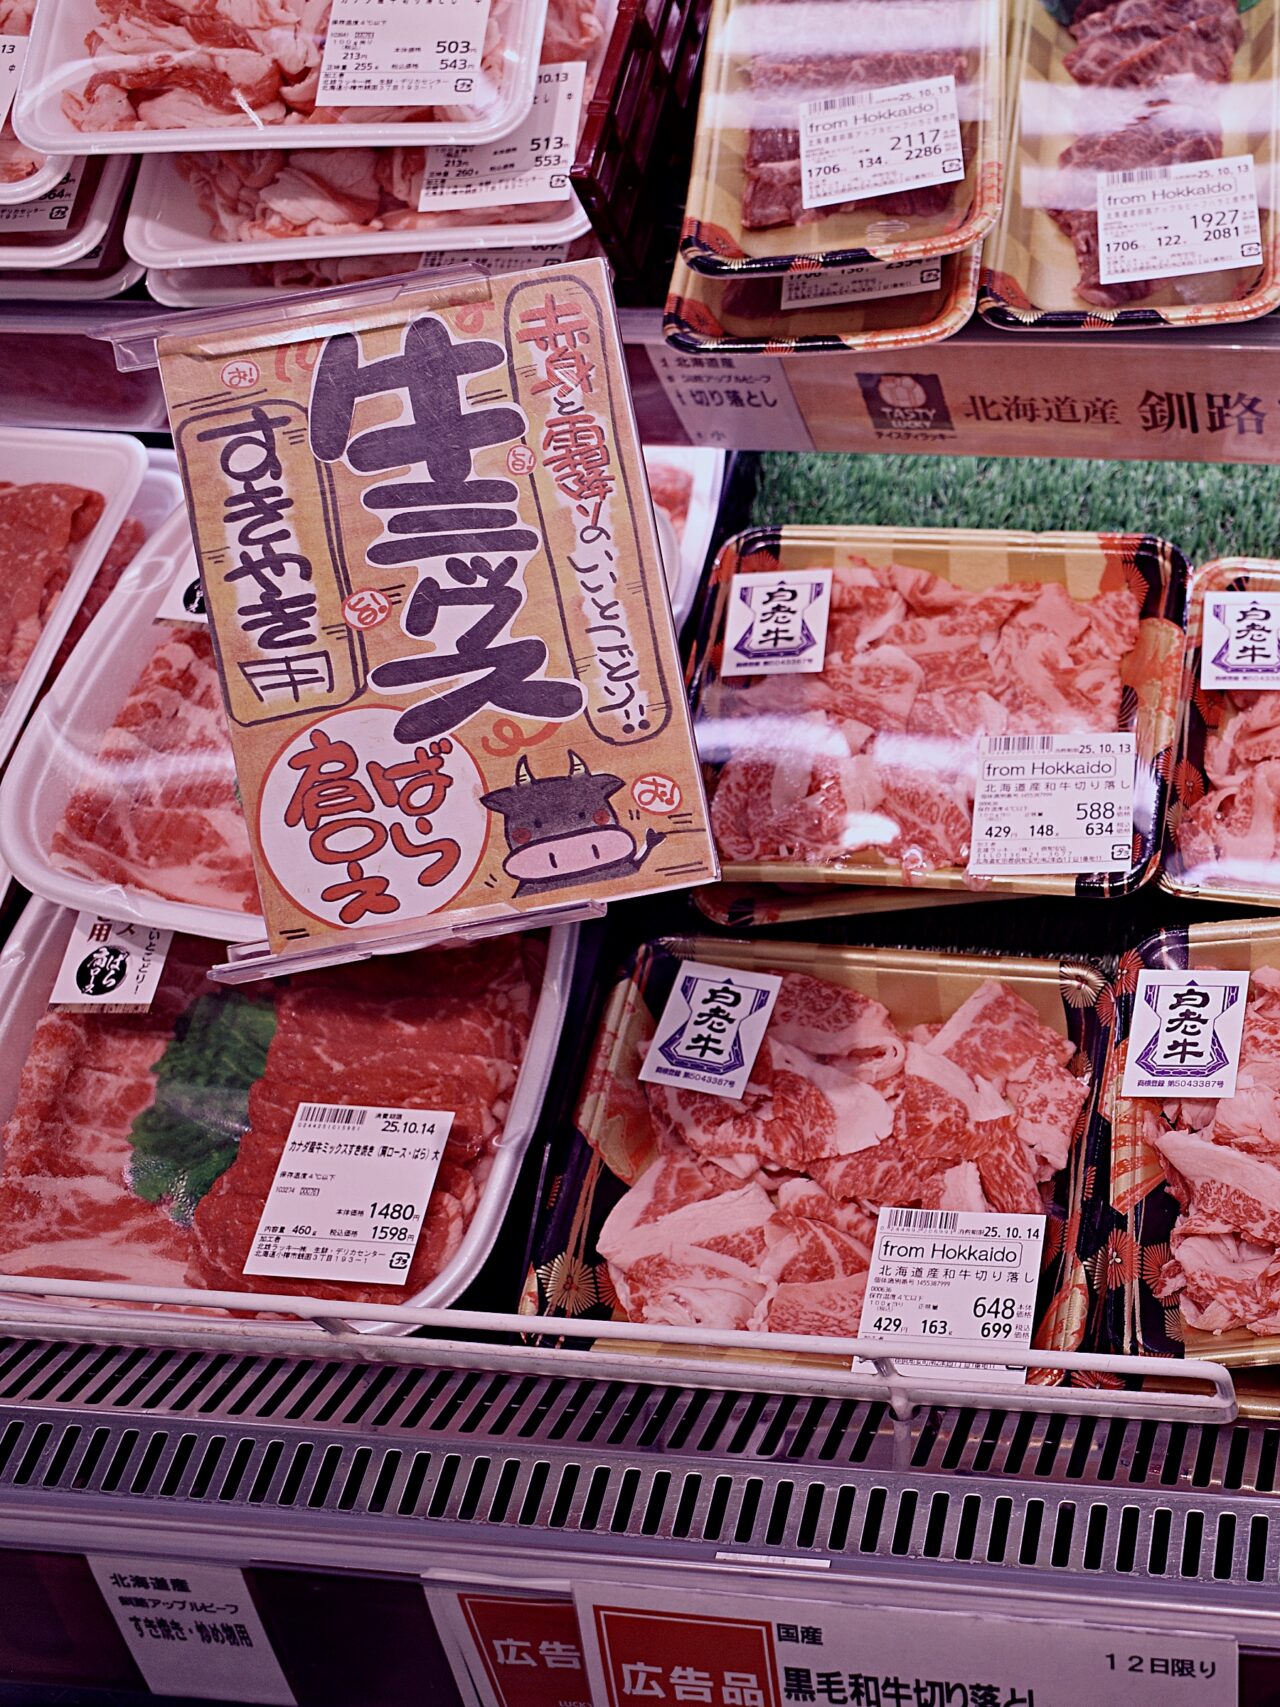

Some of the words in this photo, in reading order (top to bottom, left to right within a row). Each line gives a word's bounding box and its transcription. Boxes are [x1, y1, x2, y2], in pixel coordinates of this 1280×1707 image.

[808, 119, 848, 133] from
[854, 102, 934, 125] Hokkaido
[890, 129, 940, 150] 2117
[905, 145, 942, 161] 2286
[1107, 195, 1146, 206] from
[1152, 182, 1232, 200] Hokkaido
[1191, 210, 1239, 229] 1927
[1203, 227, 1240, 242] 2081
[676, 358, 736, 368] 北海道産
[691, 390, 778, 408] 切り落とし
[880, 407, 937, 420] TASTY
[963, 395, 1121, 426] 北海道産
[310, 316, 584, 744] 牛ミックス
[197, 406, 334, 702] すきやき用
[758, 587, 798, 648] 白老牛
[1235, 607, 1272, 664] 白老牛
[986, 763, 1025, 776] from
[1032, 760, 1112, 775] Hokkaido
[985, 780, 1130, 792] 北海道産和牛切り落し
[367, 738, 461, 887] ばら
[1076, 802, 1115, 820] 588
[284, 729, 400, 924] 肩ロース
[1085, 822, 1113, 836] 634
[685, 986, 742, 1058] 白老牛
[1163, 988, 1210, 1064] 白老牛
[381, 1121, 435, 1135] 25.10.14
[883, 1241, 924, 1258] from
[931, 1243, 1017, 1262] Hokkaido
[879, 1264, 1035, 1284] 北海道産和牛切り落し
[973, 1296, 1015, 1320] 648
[981, 1322, 1012, 1339] 699
[109, 1573, 192, 1593] 北海道産
[129, 1616, 253, 1648] すき焼き・炒め物用
[777, 1623, 824, 1646] 国産
[1104, 1653, 1218, 1679] 12日限り
[621, 1661, 764, 1707] 広告品
